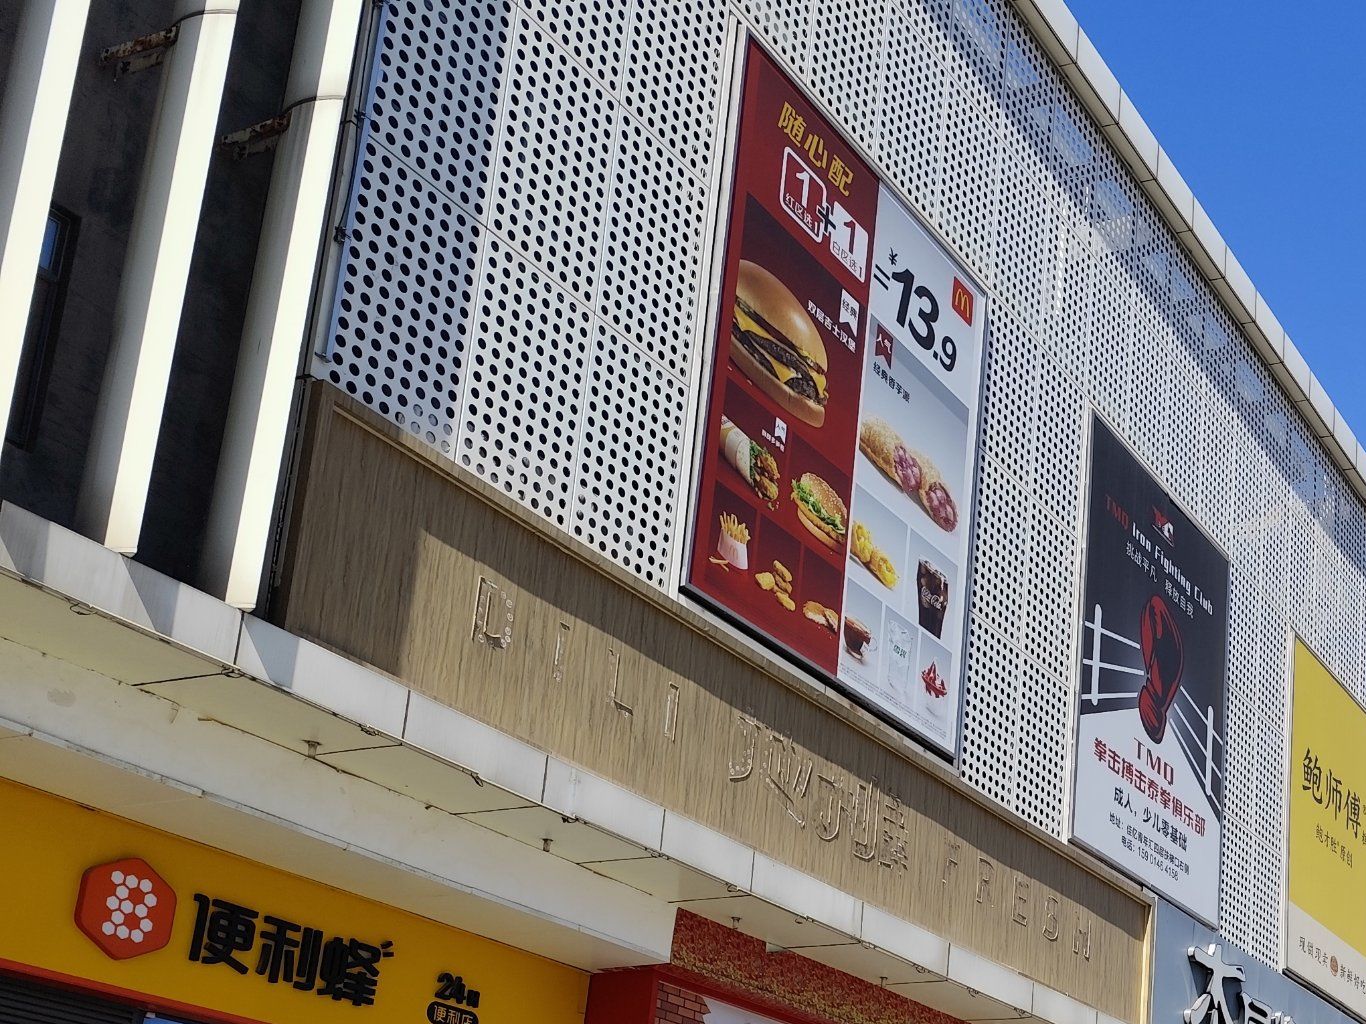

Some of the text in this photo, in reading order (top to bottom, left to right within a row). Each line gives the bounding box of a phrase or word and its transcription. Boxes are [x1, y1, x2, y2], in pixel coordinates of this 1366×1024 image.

[778, 101, 855, 197] 随心配
[875, 332, 893, 355] 人气
[1125, 540, 1194, 619] 挑战平凡 释放自我
[1132, 521, 1151, 553] Iron
[1154, 545, 1192, 596] Fighting
[1194, 584, 1214, 616] Club
[1093, 736, 1206, 838] 拳击搏击泰拳俱乐部
[1301, 747, 1363, 840] 鲍师傅
[188, 892, 395, 1007] 便利蜂
